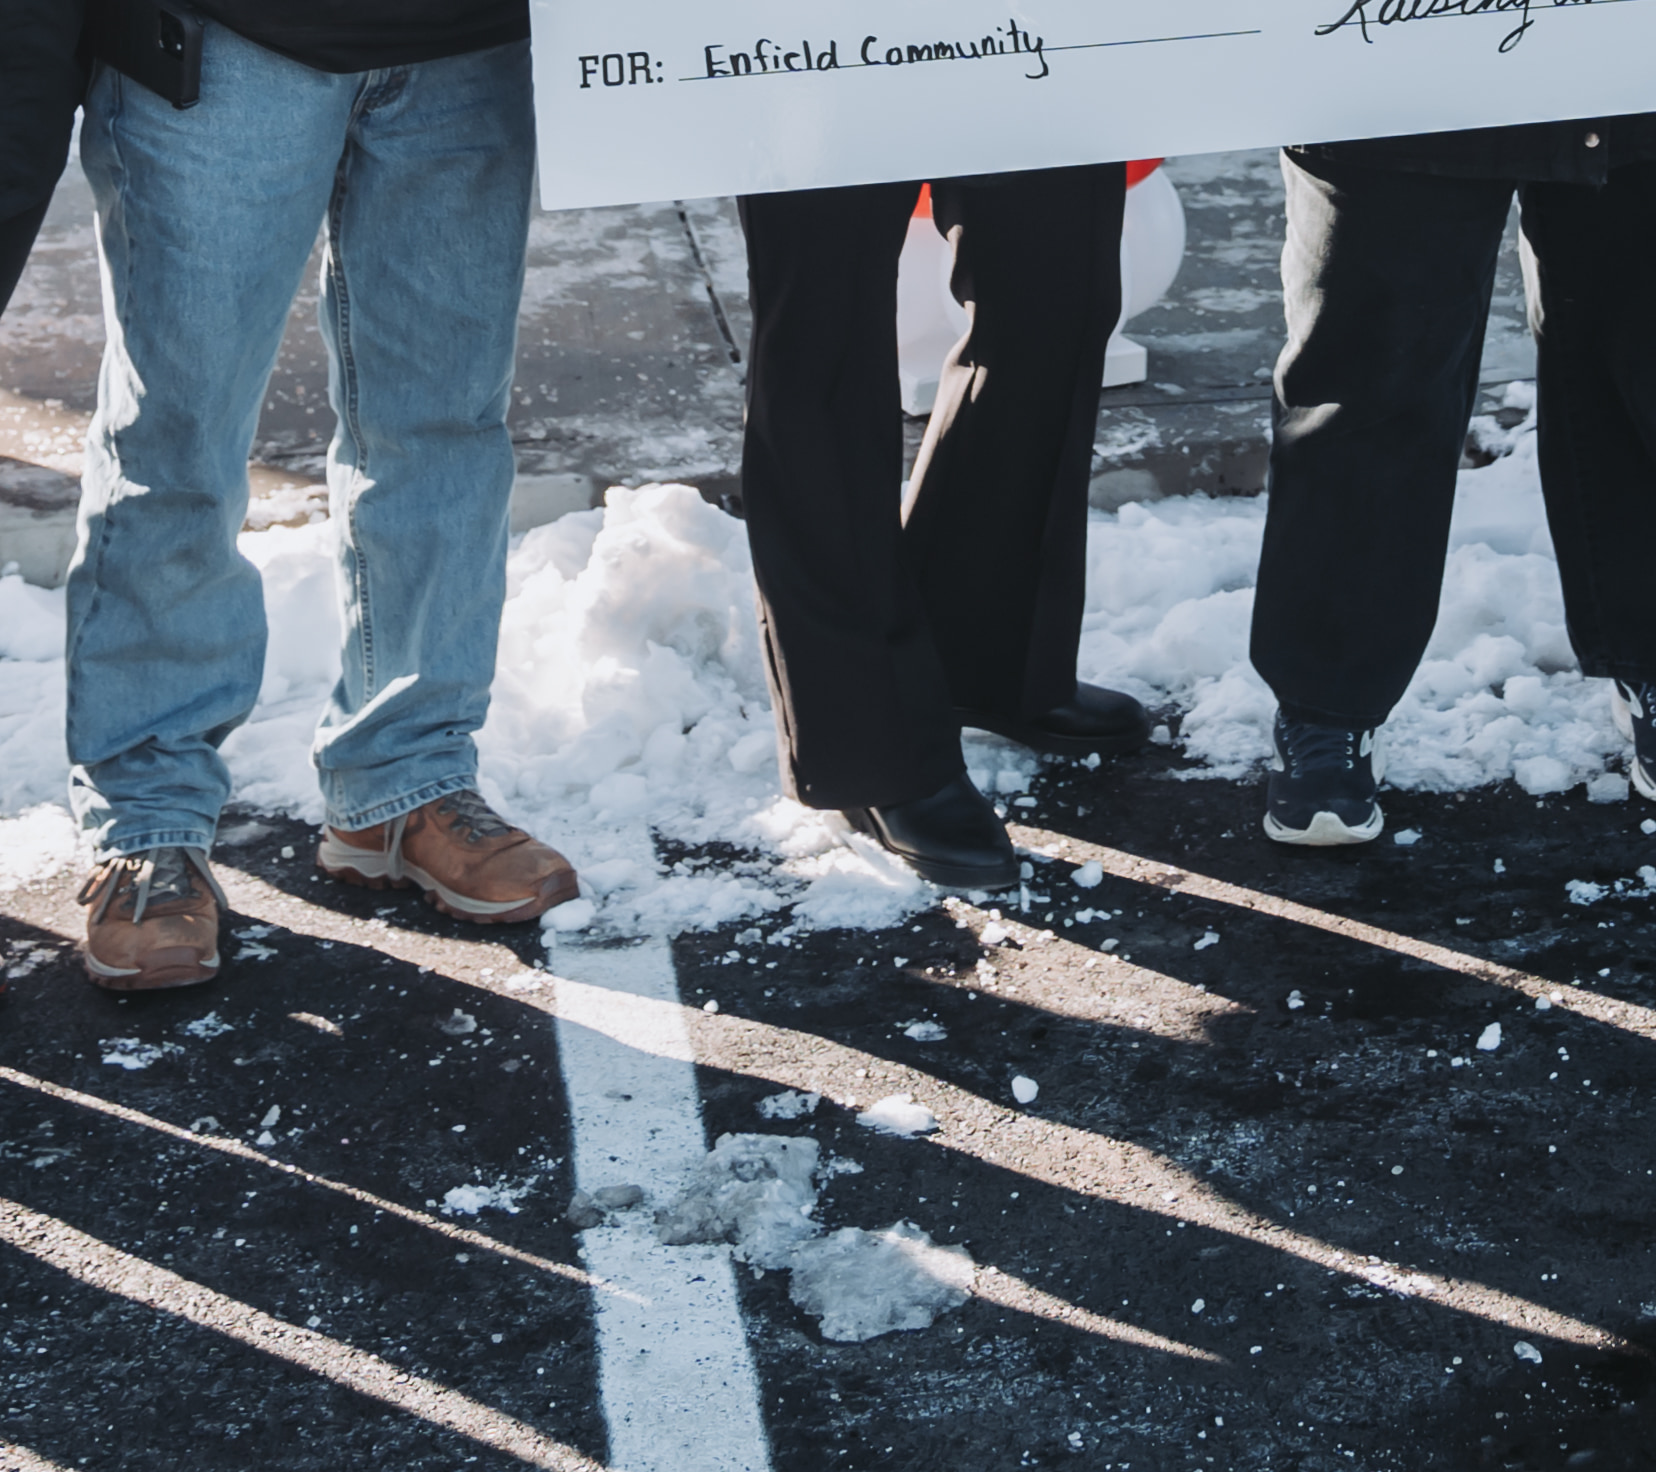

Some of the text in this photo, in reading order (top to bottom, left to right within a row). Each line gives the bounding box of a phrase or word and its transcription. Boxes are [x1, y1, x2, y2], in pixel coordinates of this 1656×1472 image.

[578, 54, 666, 89] FOR:
[704, 18, 1049, 81] Enfield Community
